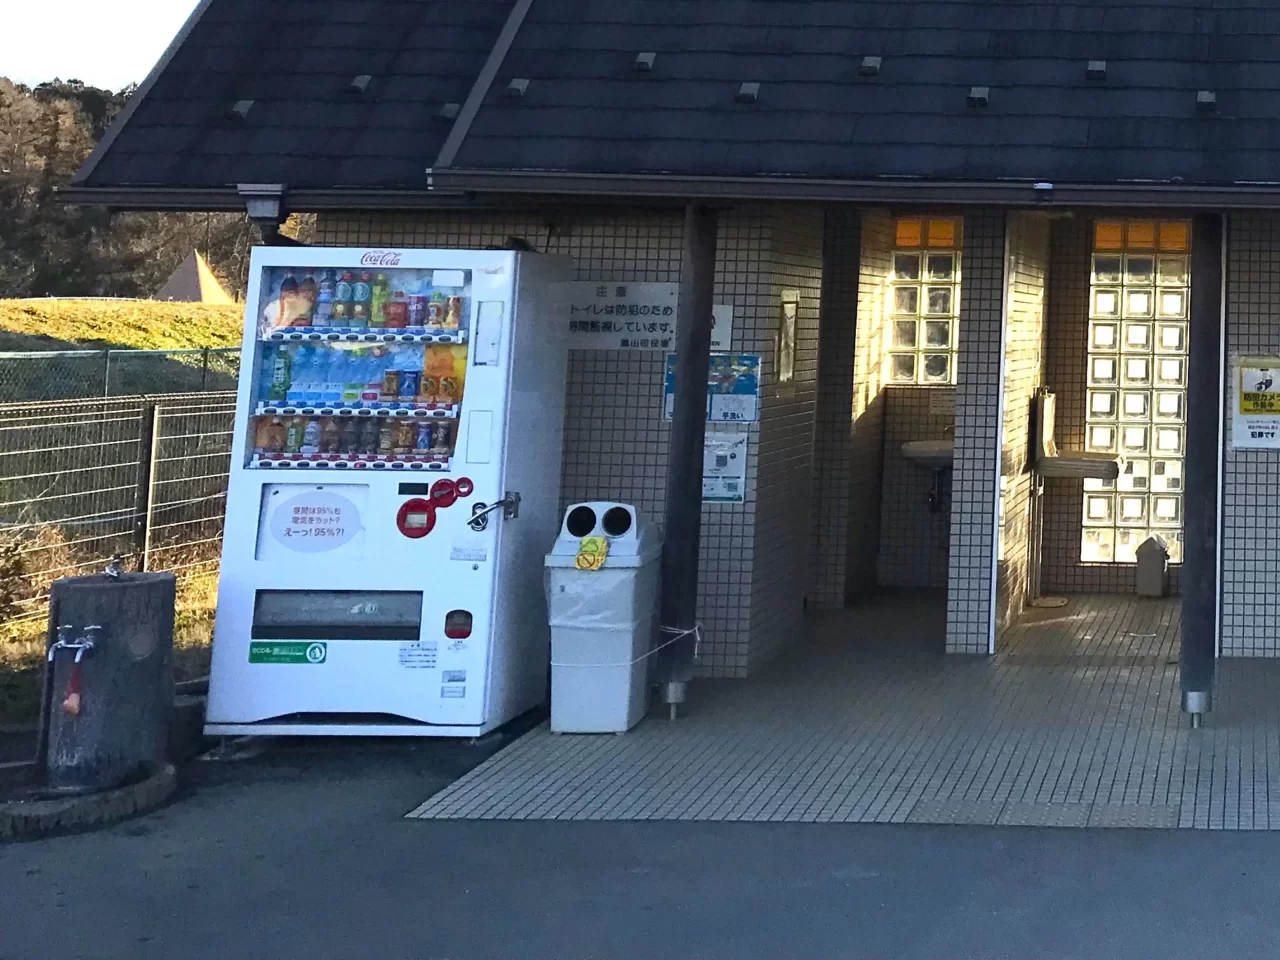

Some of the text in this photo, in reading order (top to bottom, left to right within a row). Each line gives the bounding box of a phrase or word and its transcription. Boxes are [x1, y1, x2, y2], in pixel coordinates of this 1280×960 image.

[570, 304, 673, 316] トイレは防犯のため
